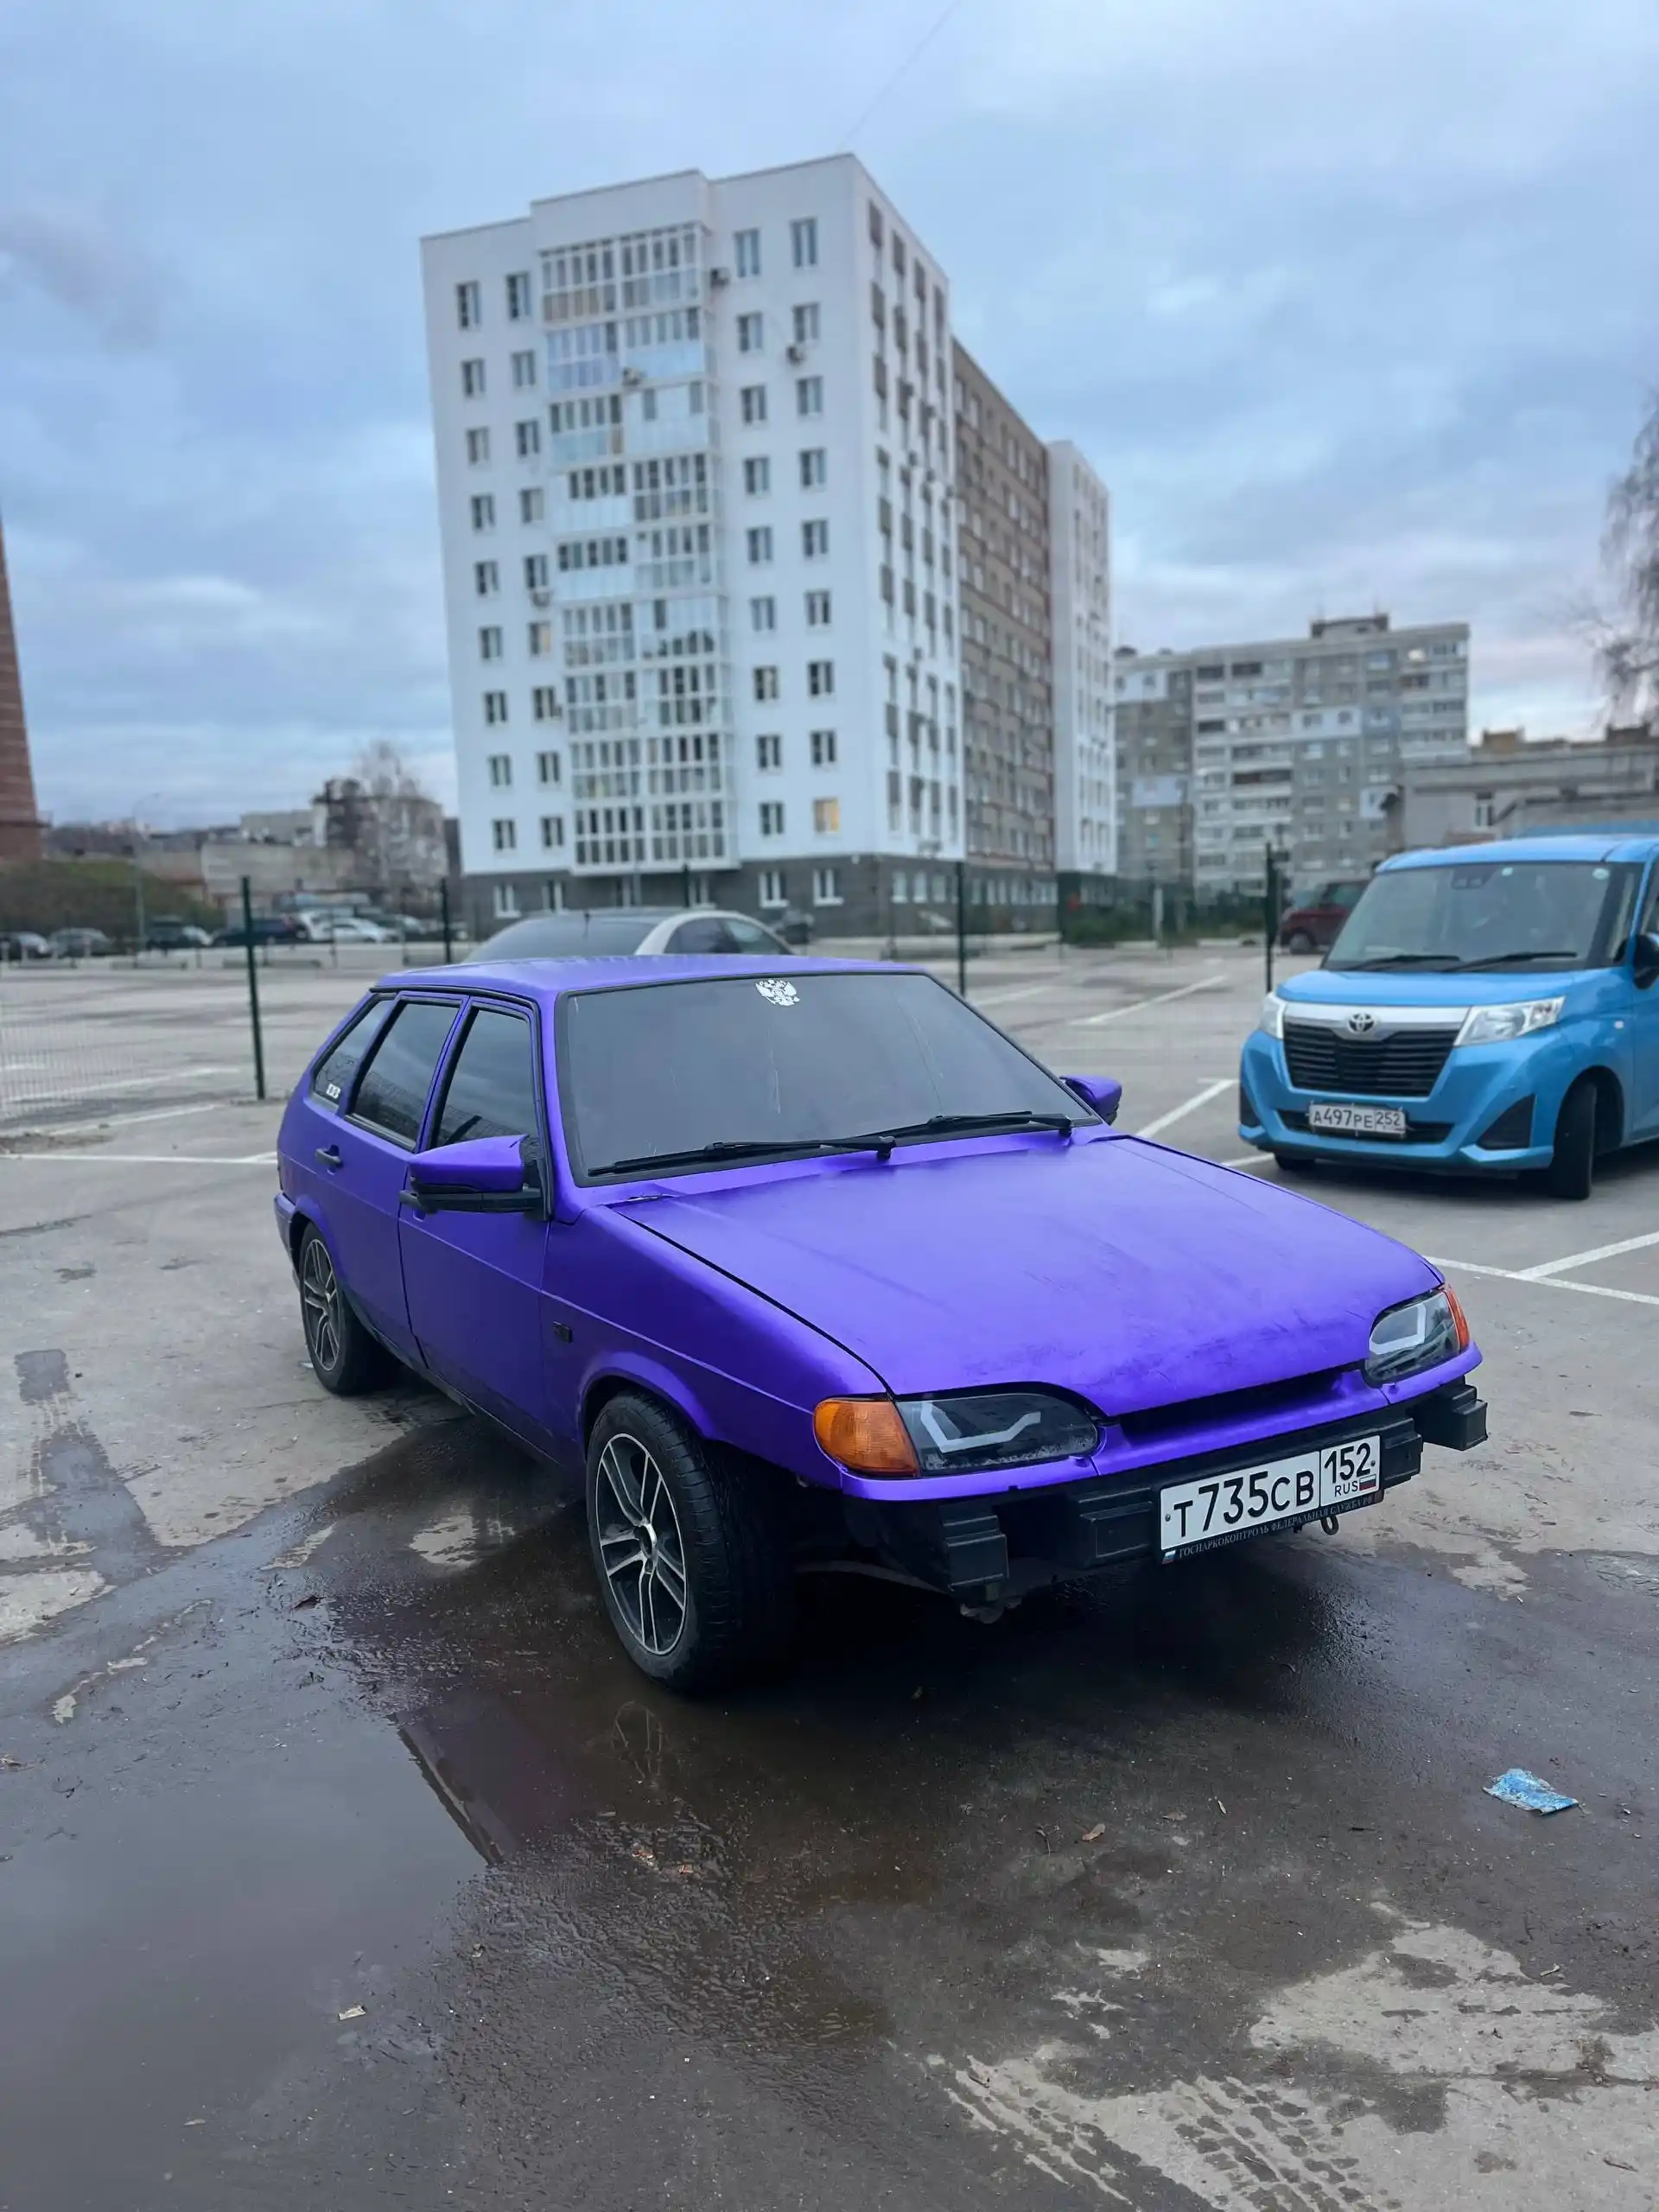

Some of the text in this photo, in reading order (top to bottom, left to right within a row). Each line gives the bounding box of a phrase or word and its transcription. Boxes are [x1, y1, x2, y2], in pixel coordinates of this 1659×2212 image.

[1376, 1111, 1401, 1126] 252
[1173, 1442, 1371, 1537] Т735СВ 152
[1334, 1484, 1358, 1497] RUS
